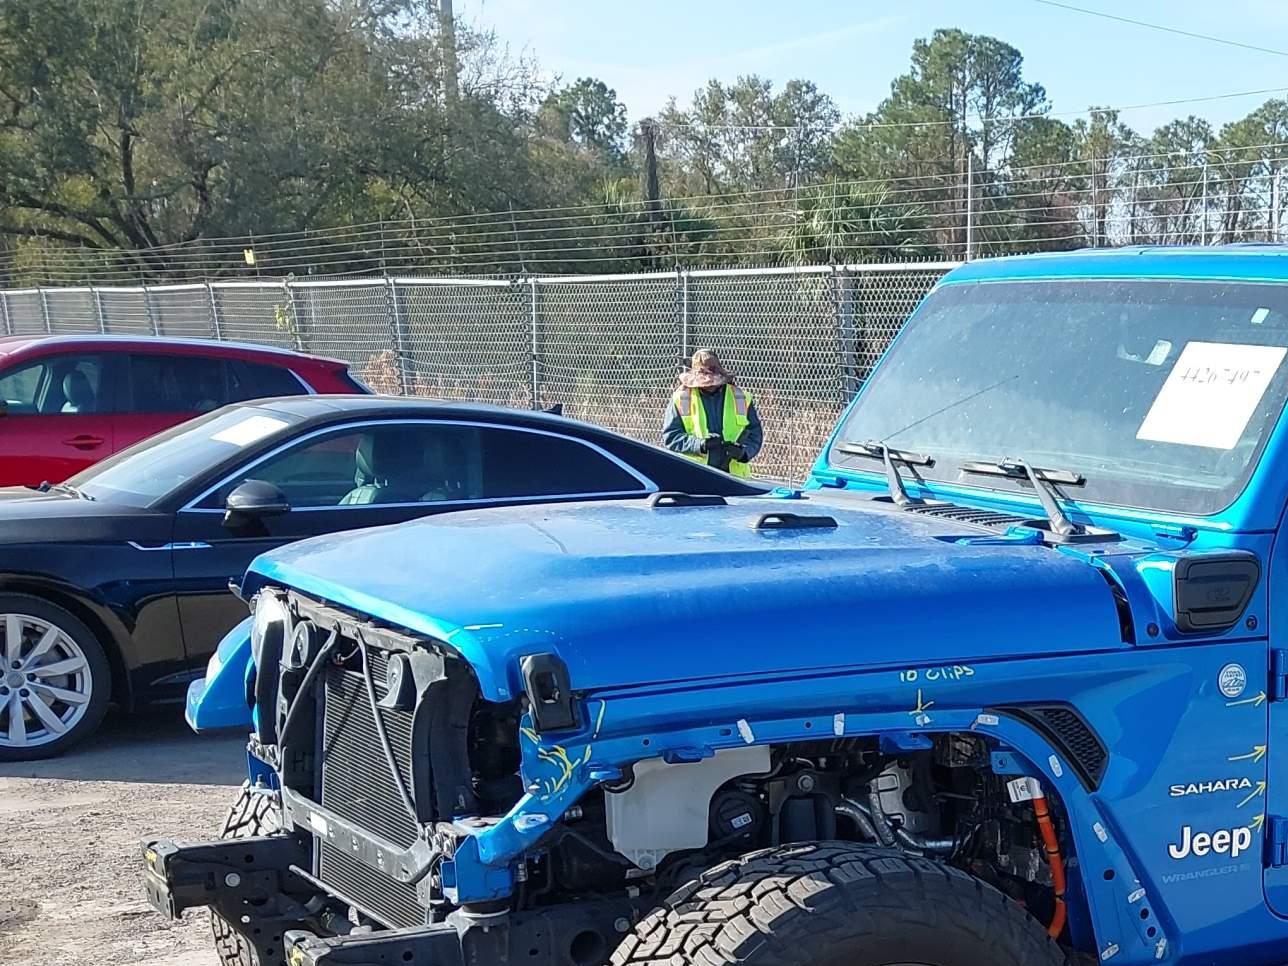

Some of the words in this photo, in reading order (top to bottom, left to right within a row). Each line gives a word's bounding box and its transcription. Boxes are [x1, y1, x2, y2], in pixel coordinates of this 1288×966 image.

[900, 669, 918, 682] 10
[1169, 777, 1252, 797] SAHARA
[1168, 826, 1251, 859] Jeep
[1161, 863, 1238, 885] WRANGLER
